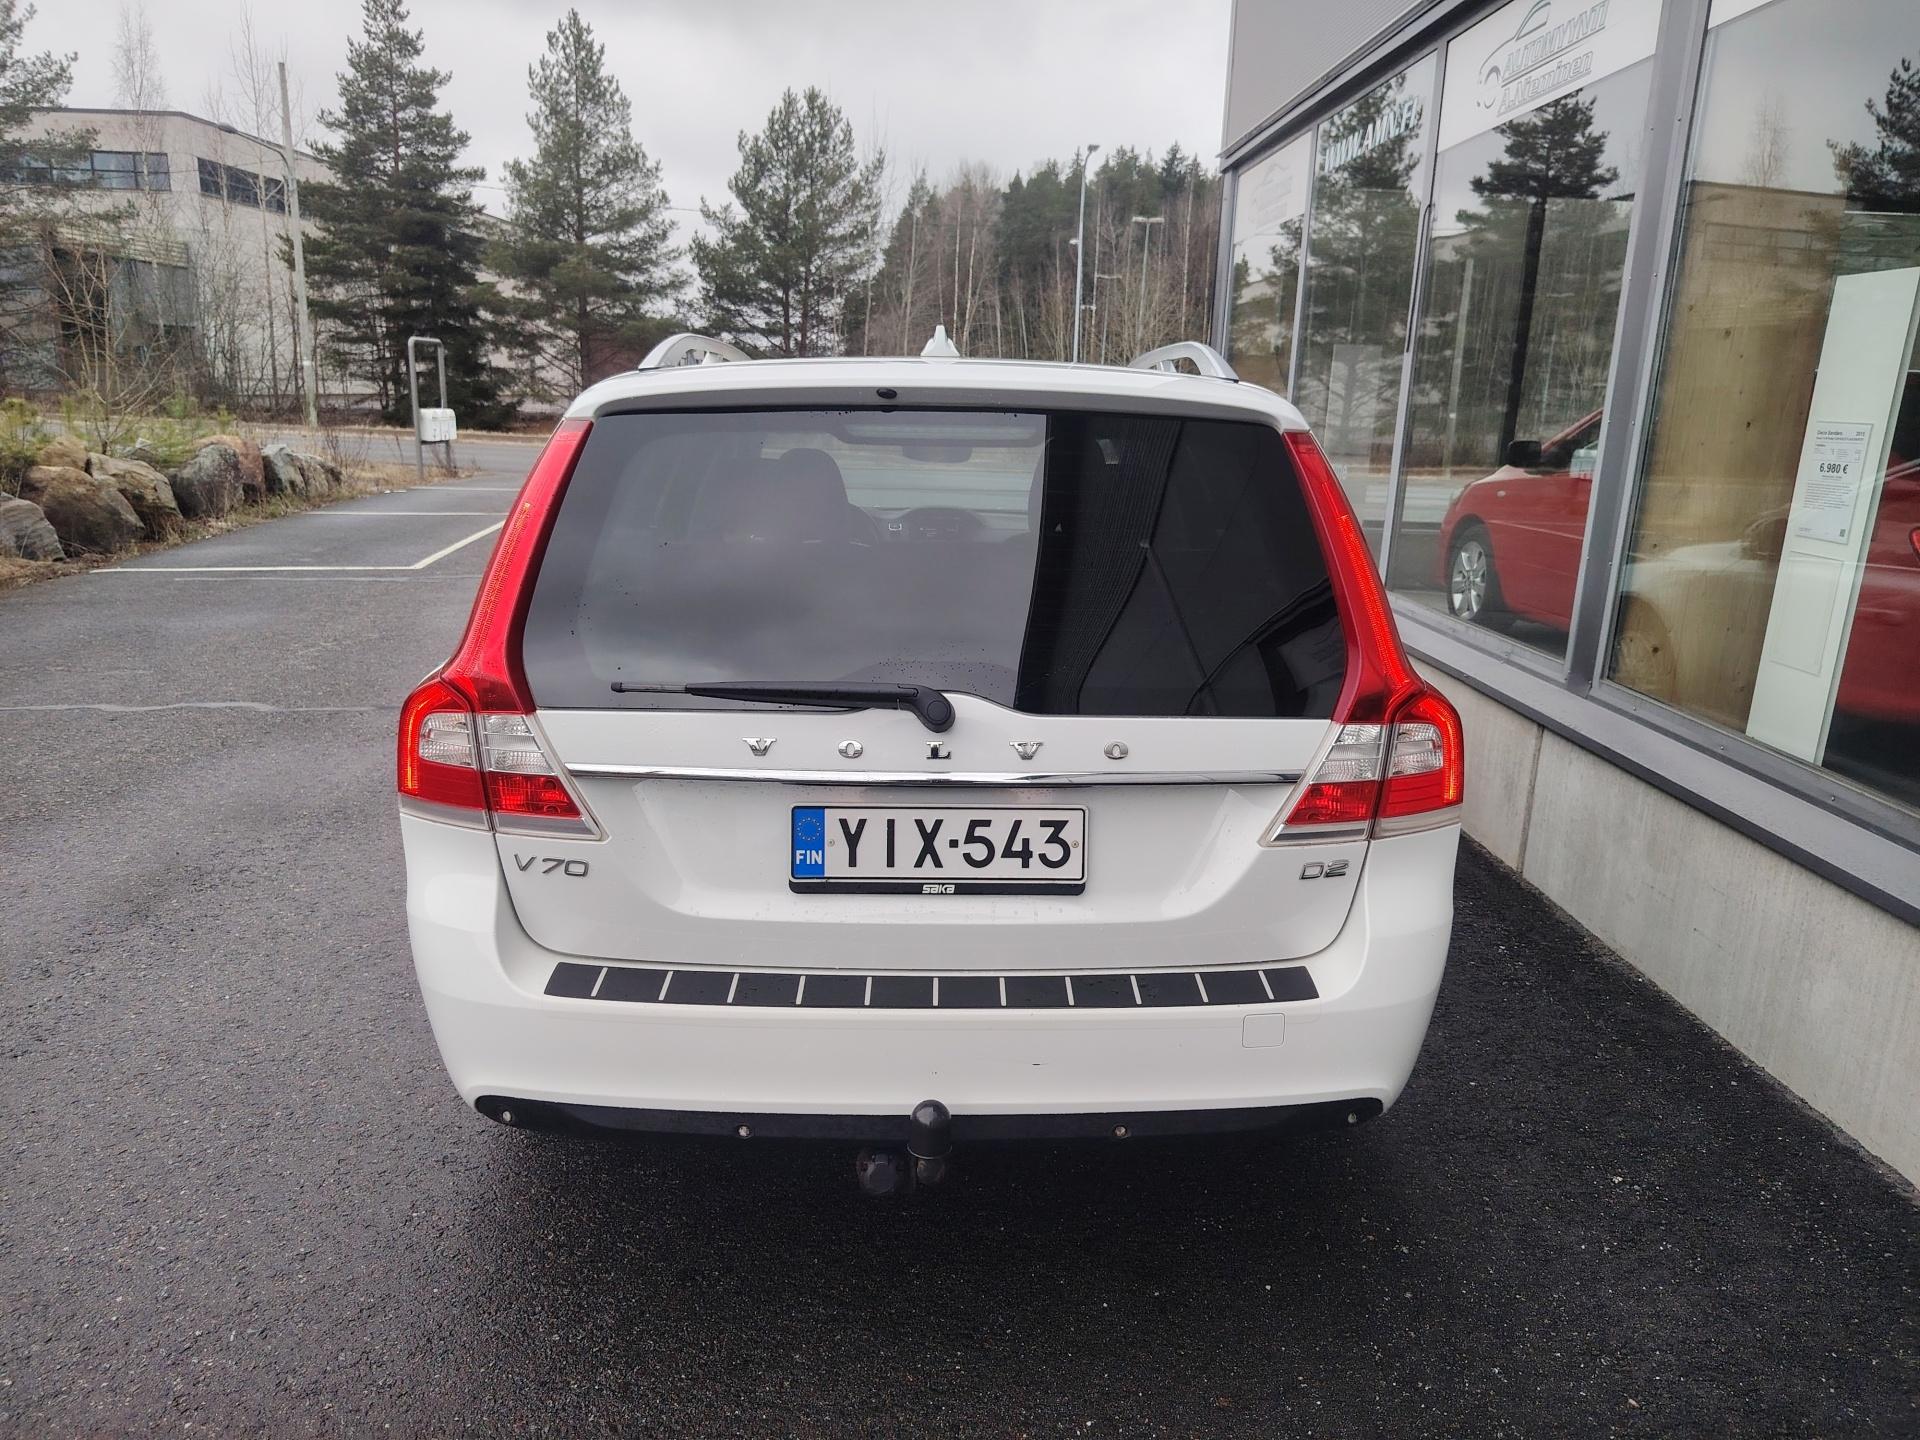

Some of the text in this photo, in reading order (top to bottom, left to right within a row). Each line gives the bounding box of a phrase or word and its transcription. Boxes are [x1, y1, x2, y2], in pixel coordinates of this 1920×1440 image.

[1819, 462, 1849, 474] 6.980 €
[742, 737, 1130, 761] VOLVO
[838, 818, 1072, 869] YIX-543
[514, 853, 590, 877] V70
[796, 850, 822, 865] FIN
[1299, 859, 1350, 880] D2
[922, 884, 956, 894] saka
